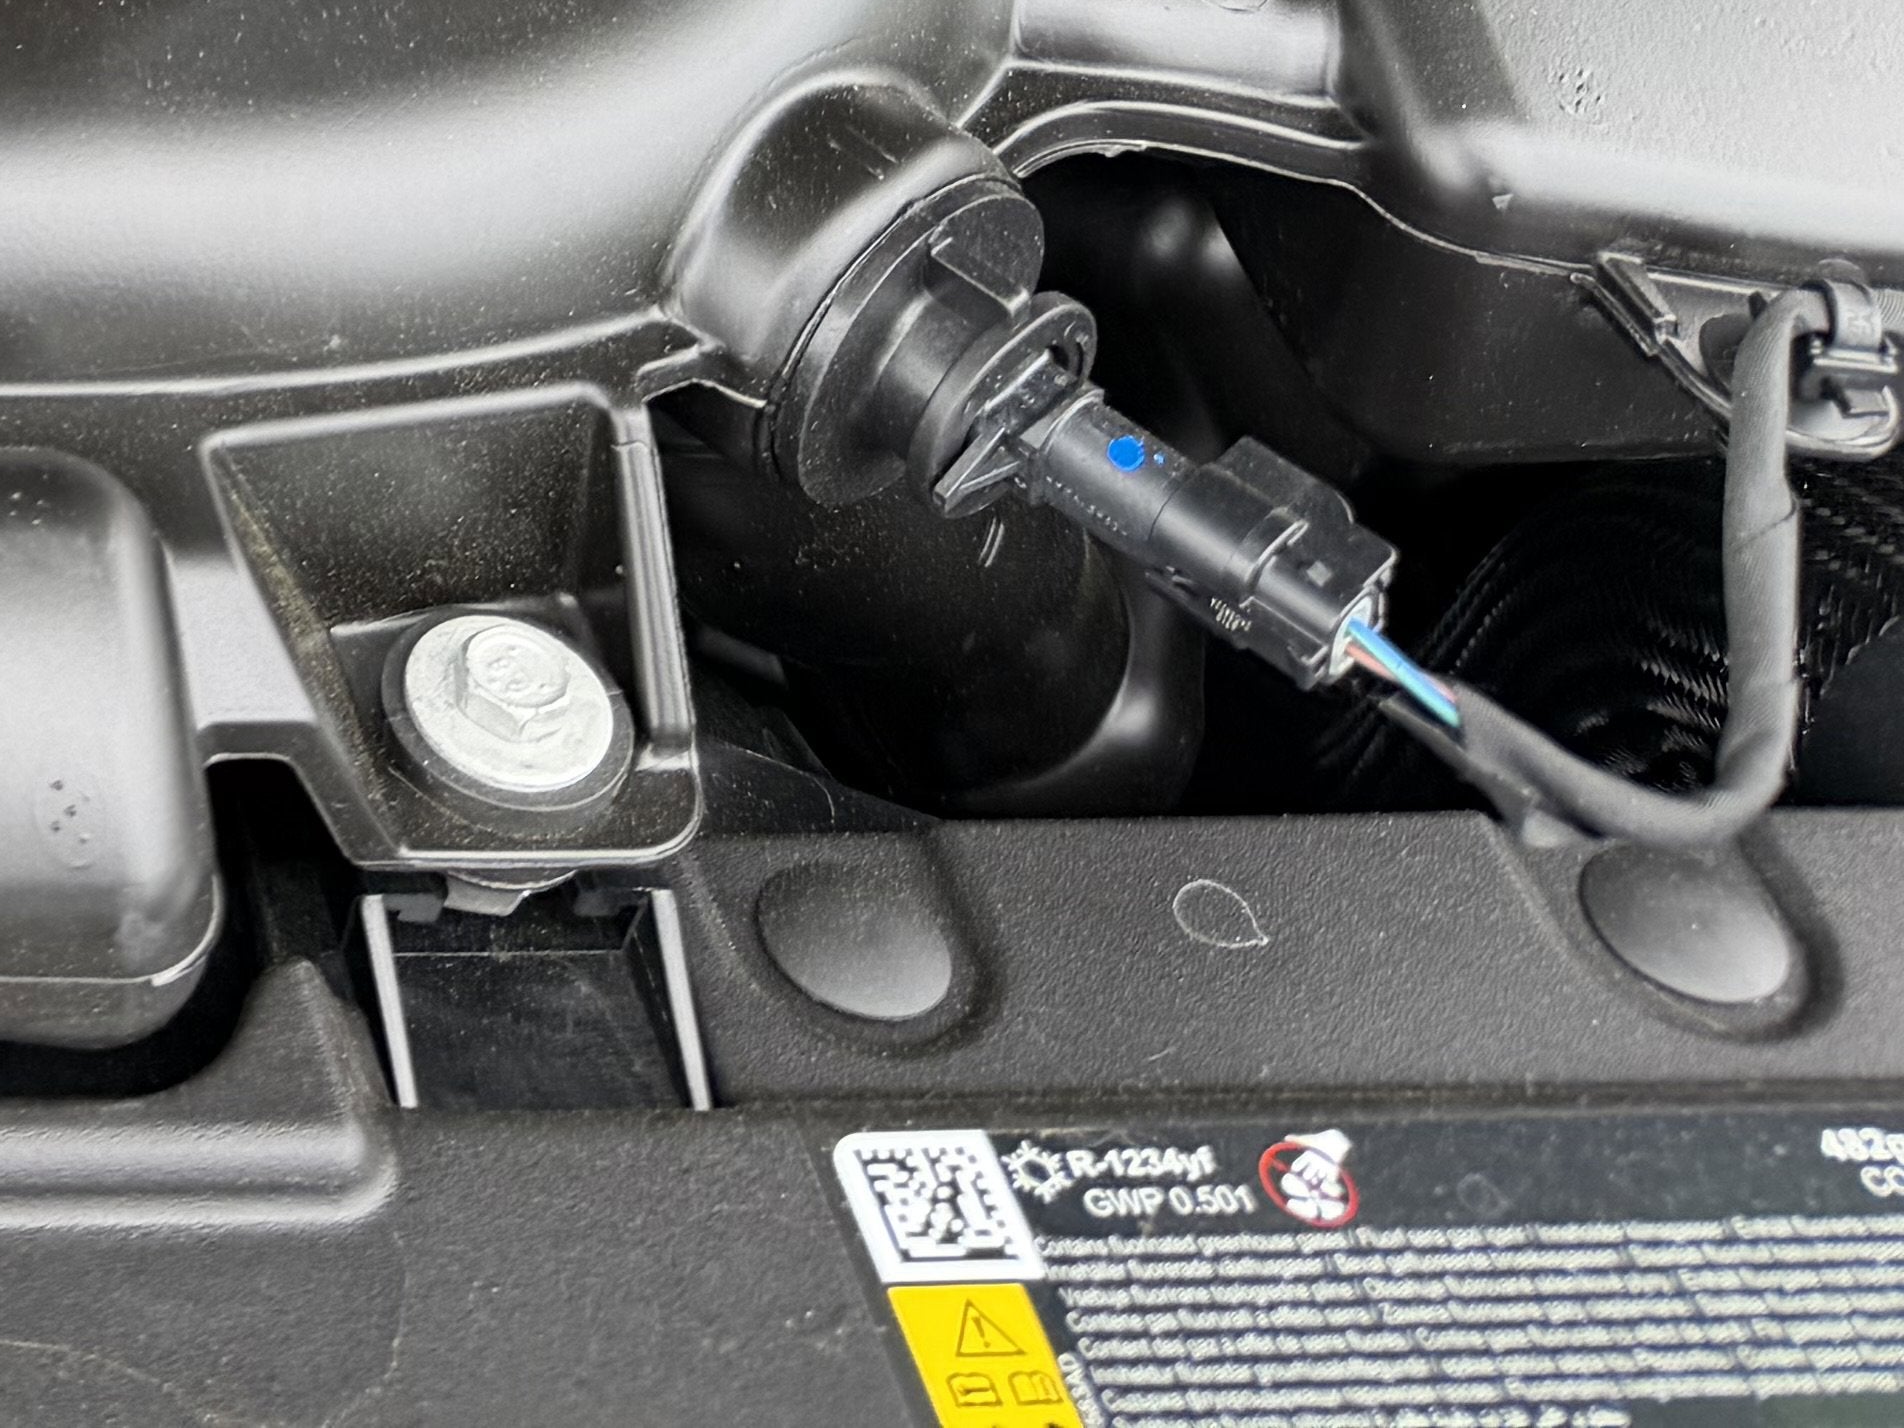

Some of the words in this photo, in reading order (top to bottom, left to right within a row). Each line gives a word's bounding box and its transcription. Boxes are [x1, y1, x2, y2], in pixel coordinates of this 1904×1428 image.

[1066, 1145, 1218, 1182] R-1234yf
[1083, 1186, 1164, 1218] GWP
[1169, 1183, 1258, 1216] 0.501
